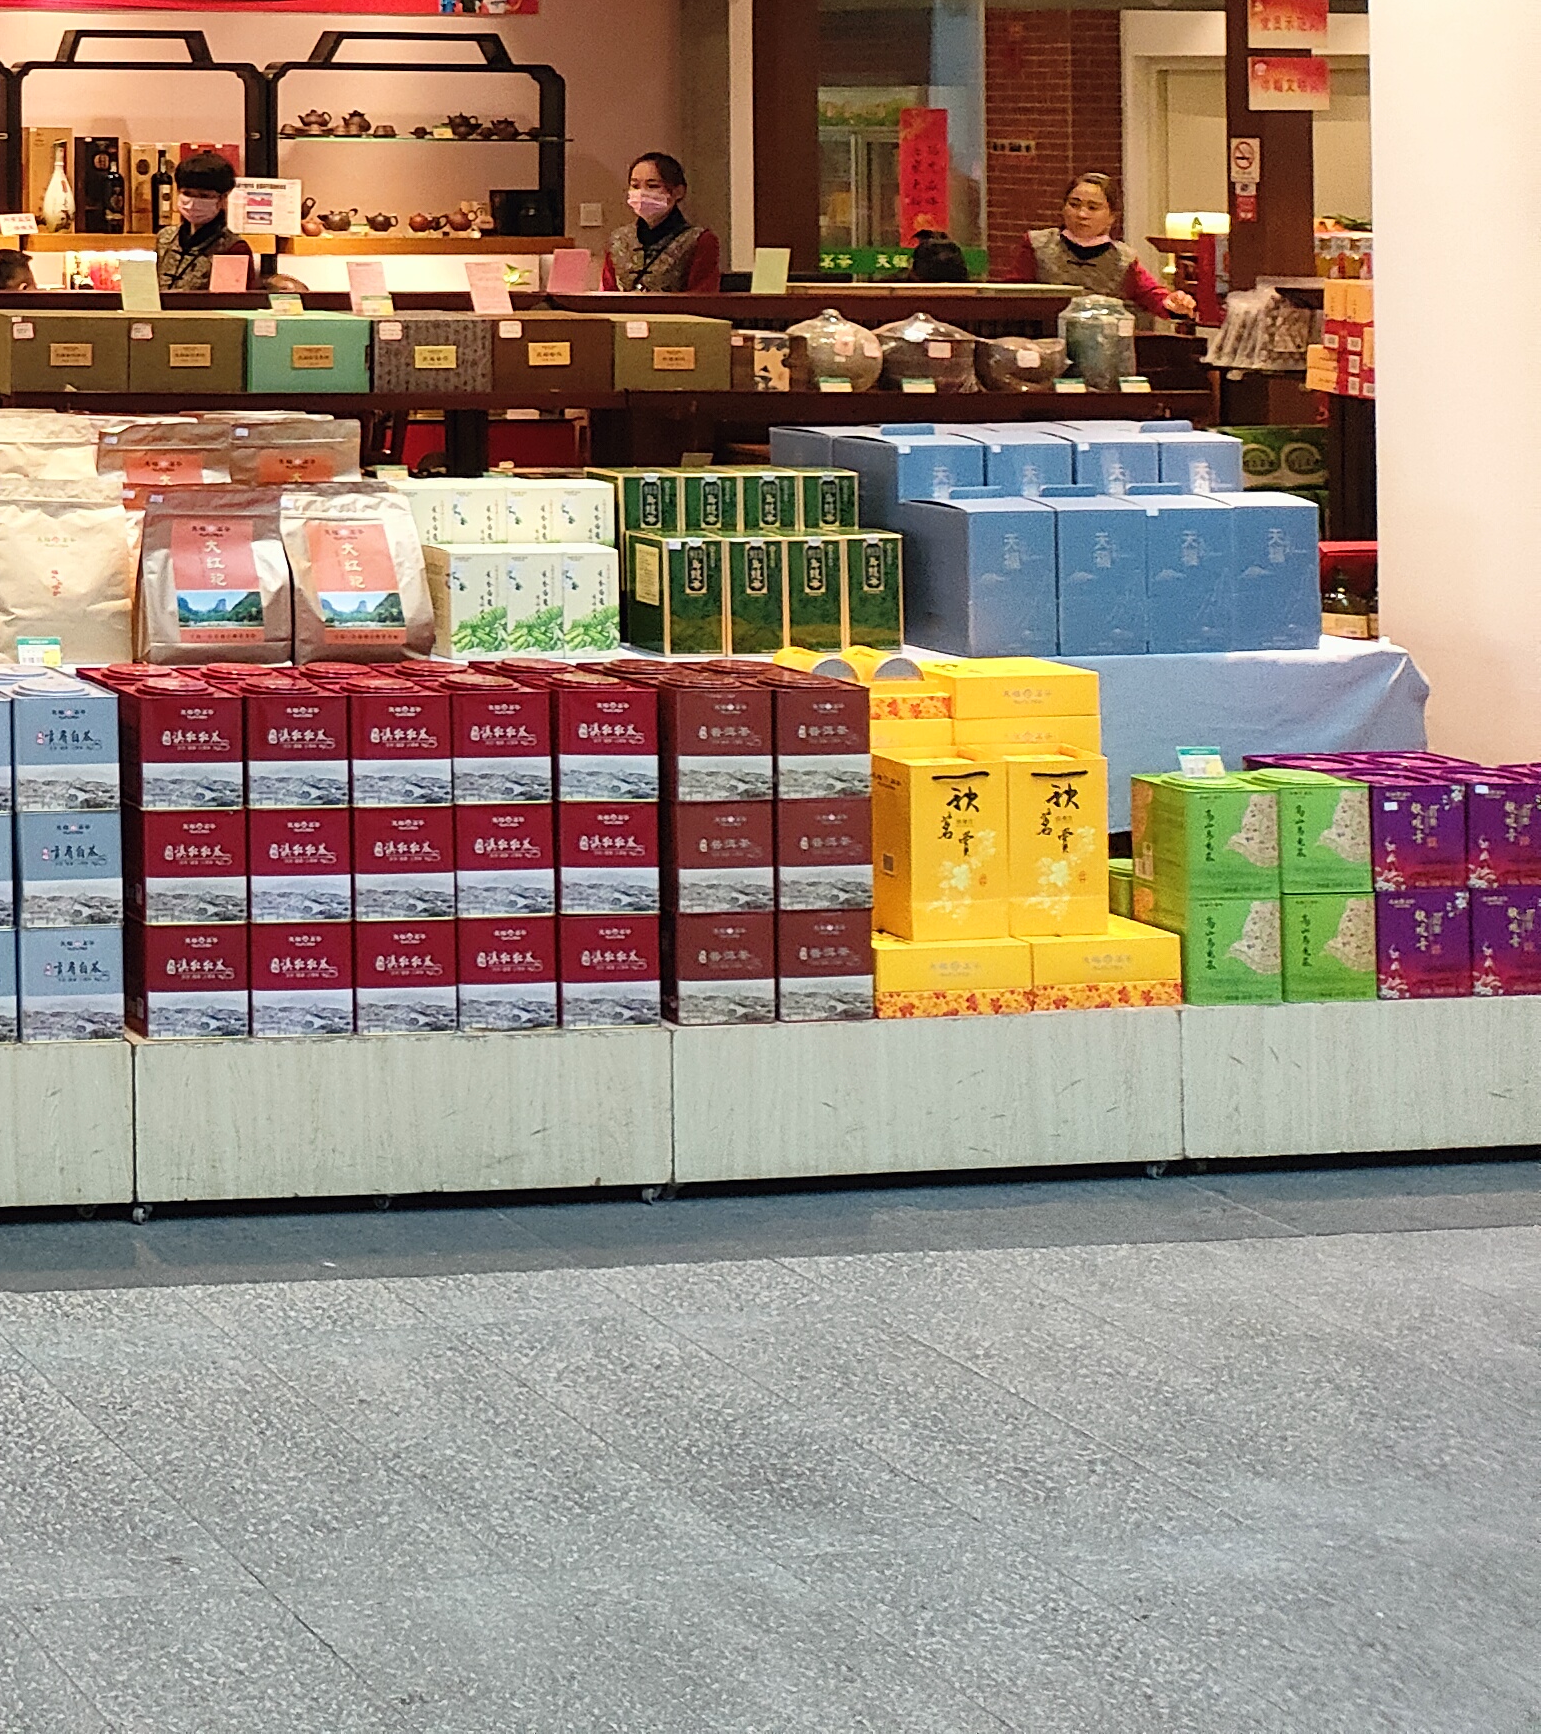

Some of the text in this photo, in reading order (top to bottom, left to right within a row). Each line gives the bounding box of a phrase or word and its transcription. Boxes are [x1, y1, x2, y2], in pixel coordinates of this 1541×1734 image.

[204, 539, 227, 587] 大红袍
[341, 541, 367, 589] 大红袍
